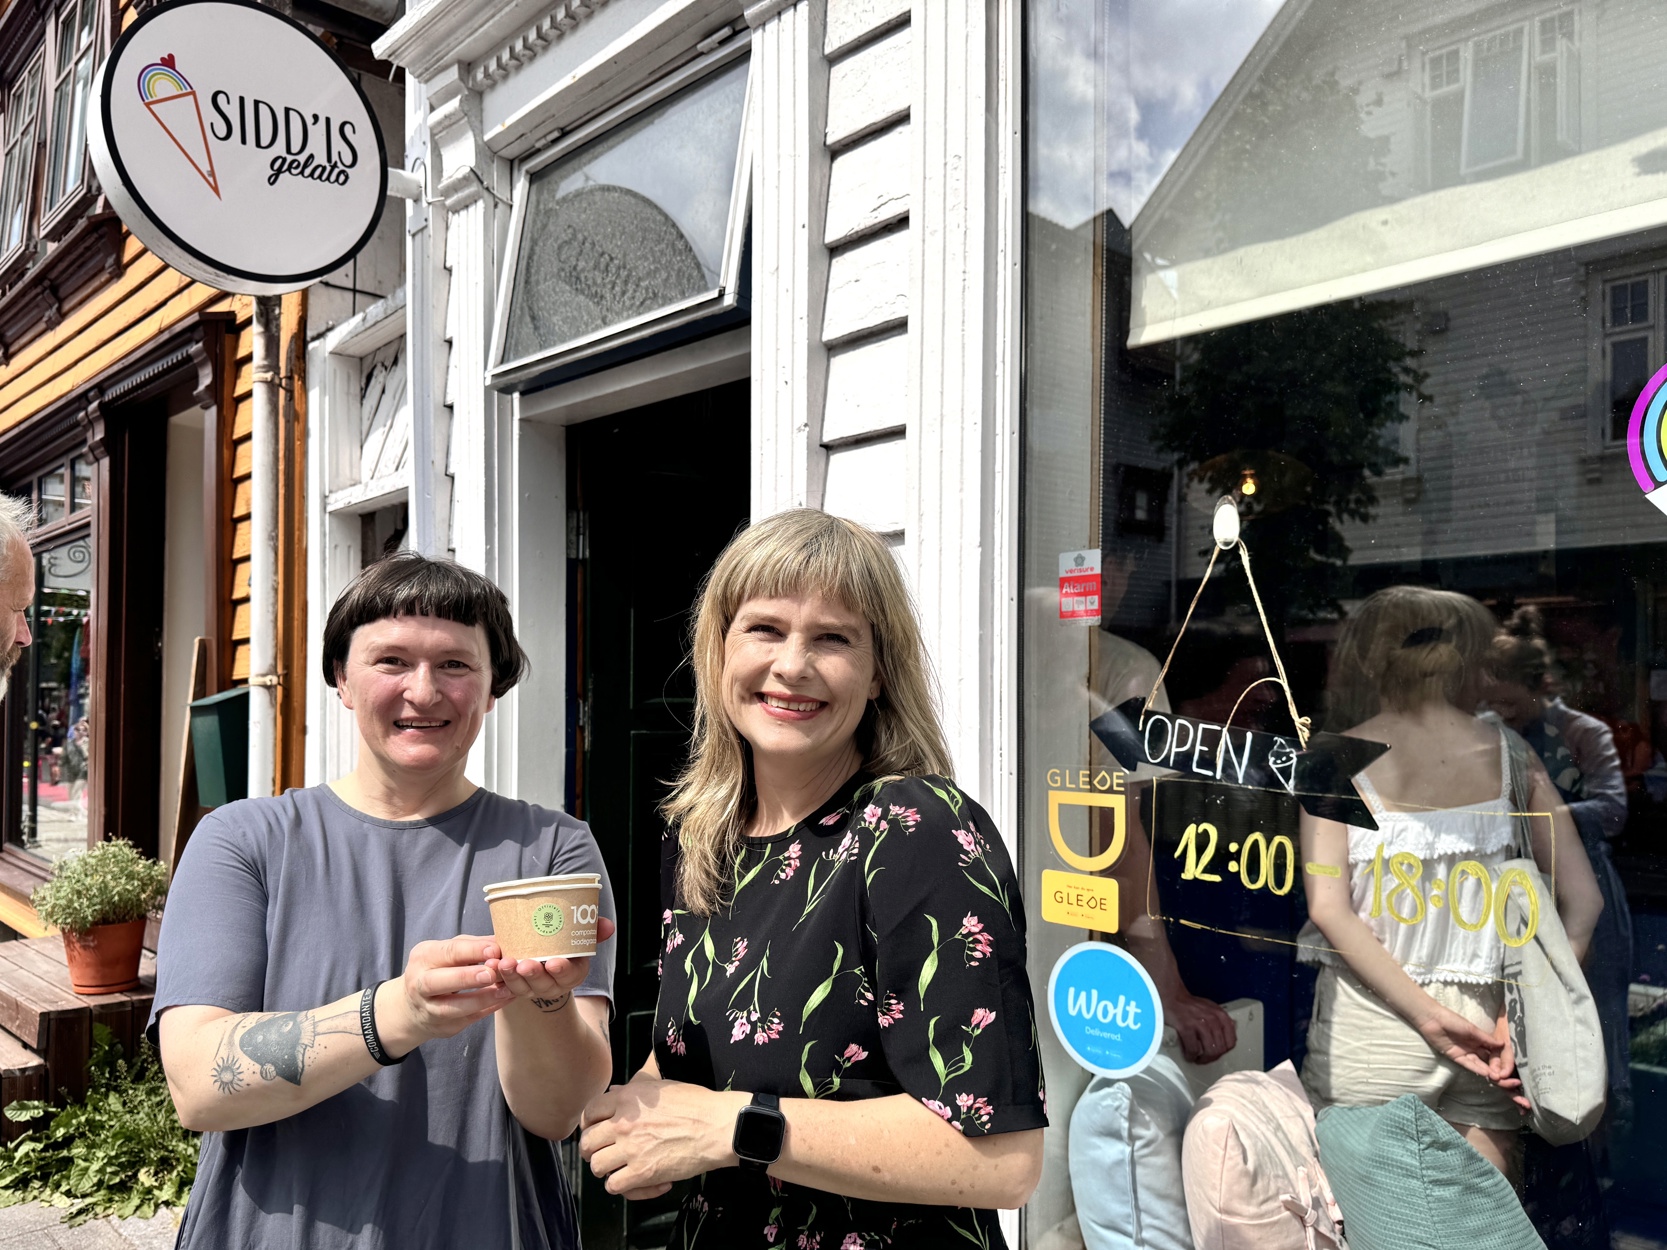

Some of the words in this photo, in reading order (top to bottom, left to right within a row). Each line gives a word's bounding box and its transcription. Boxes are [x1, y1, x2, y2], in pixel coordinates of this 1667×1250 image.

[210, 90, 358, 169] SIDD'IS
[267, 153, 350, 186] gelato
[1062, 581, 1097, 594] Alarm
[1065, 566, 1095, 574] verisure
[1143, 714, 1253, 784] OPEN
[1174, 822, 1294, 896] 12:00
[1360, 842, 1539, 948] 18:00
[570, 904, 598, 925] 100
[361, 994, 379, 1053] COMANDANTE
[1067, 986, 1142, 1030] Wolt
